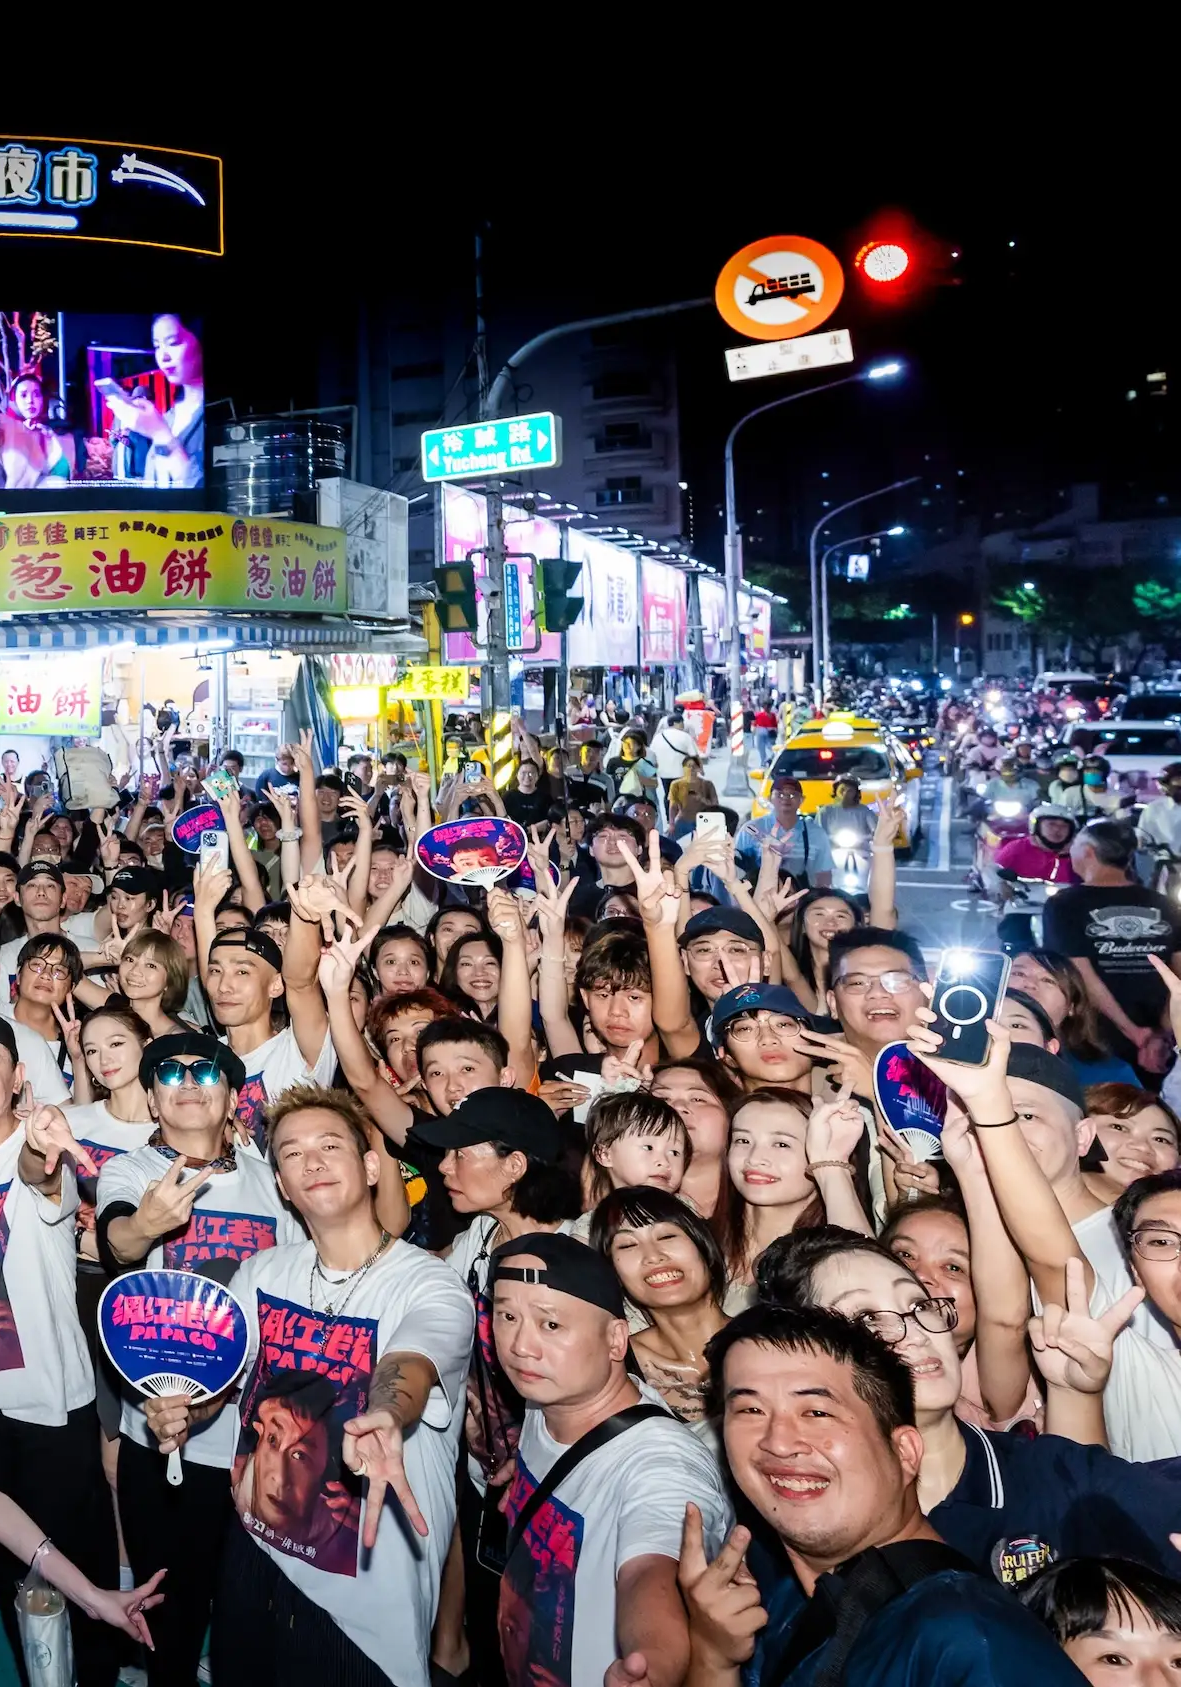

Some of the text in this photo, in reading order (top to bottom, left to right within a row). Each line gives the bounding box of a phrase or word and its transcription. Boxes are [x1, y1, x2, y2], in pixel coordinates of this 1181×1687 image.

[443, 451, 508, 473] Yucheng
[74, 527, 109, 540] 純手工
[232, 521, 273, 549] 何佳佳
[7, 547, 212, 600] 葱油餅
[245, 553, 337, 601] 葱油餅
[1094, 941, 1167, 954] Budweiser
[129, 1325, 217, 1351] PA PA GO
[265, 1346, 296, 1369] PA
[1004, 1554, 1026, 1569] RUI
